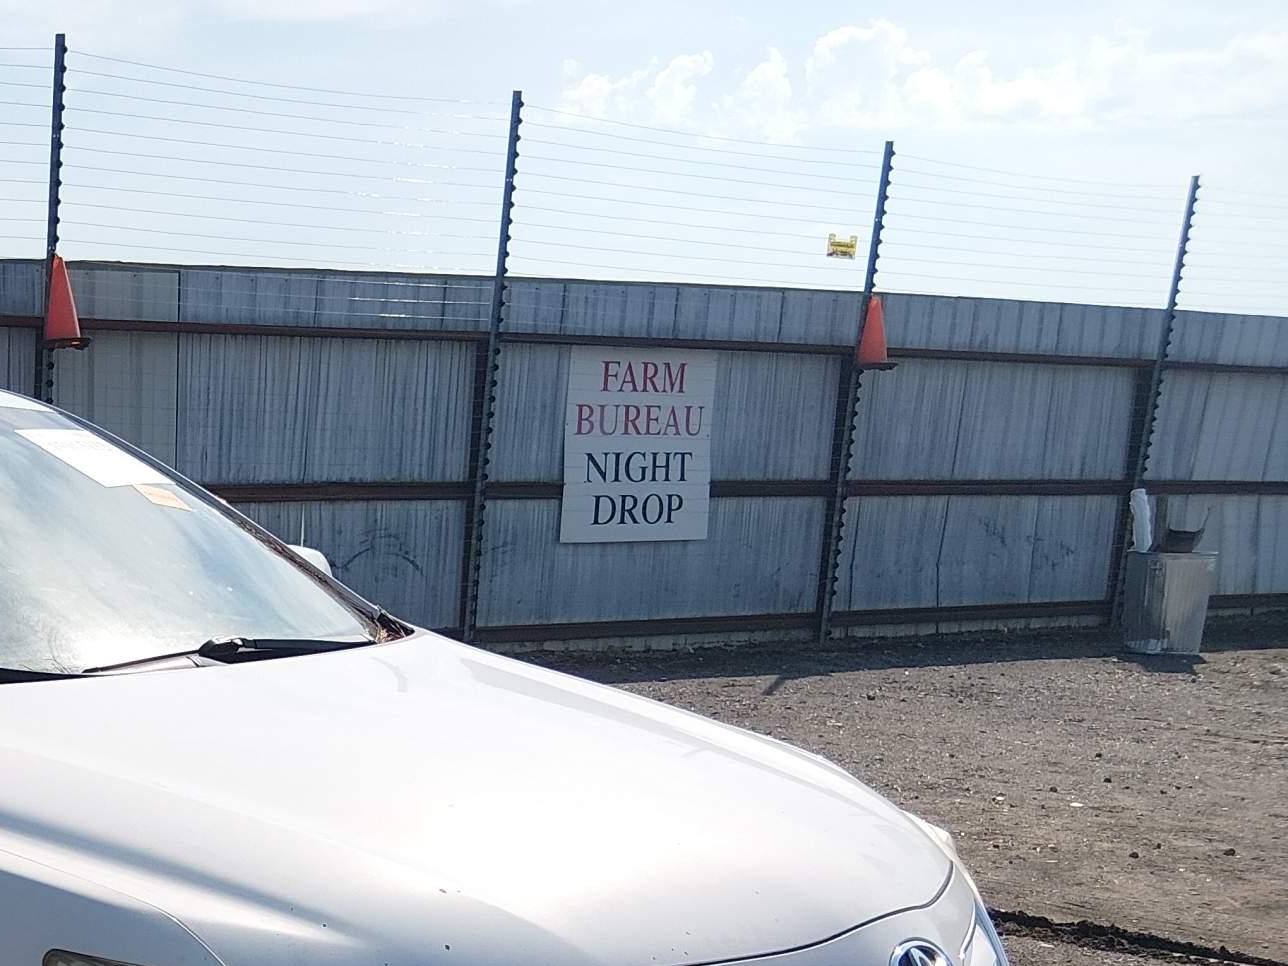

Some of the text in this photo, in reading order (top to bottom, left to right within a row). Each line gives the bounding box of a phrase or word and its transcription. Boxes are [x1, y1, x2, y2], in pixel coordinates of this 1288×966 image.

[600, 360, 688, 394] FARM
[574, 404, 705, 436] BUREAU
[584, 451, 693, 483] NIGHT
[590, 493, 683, 525] DROP
